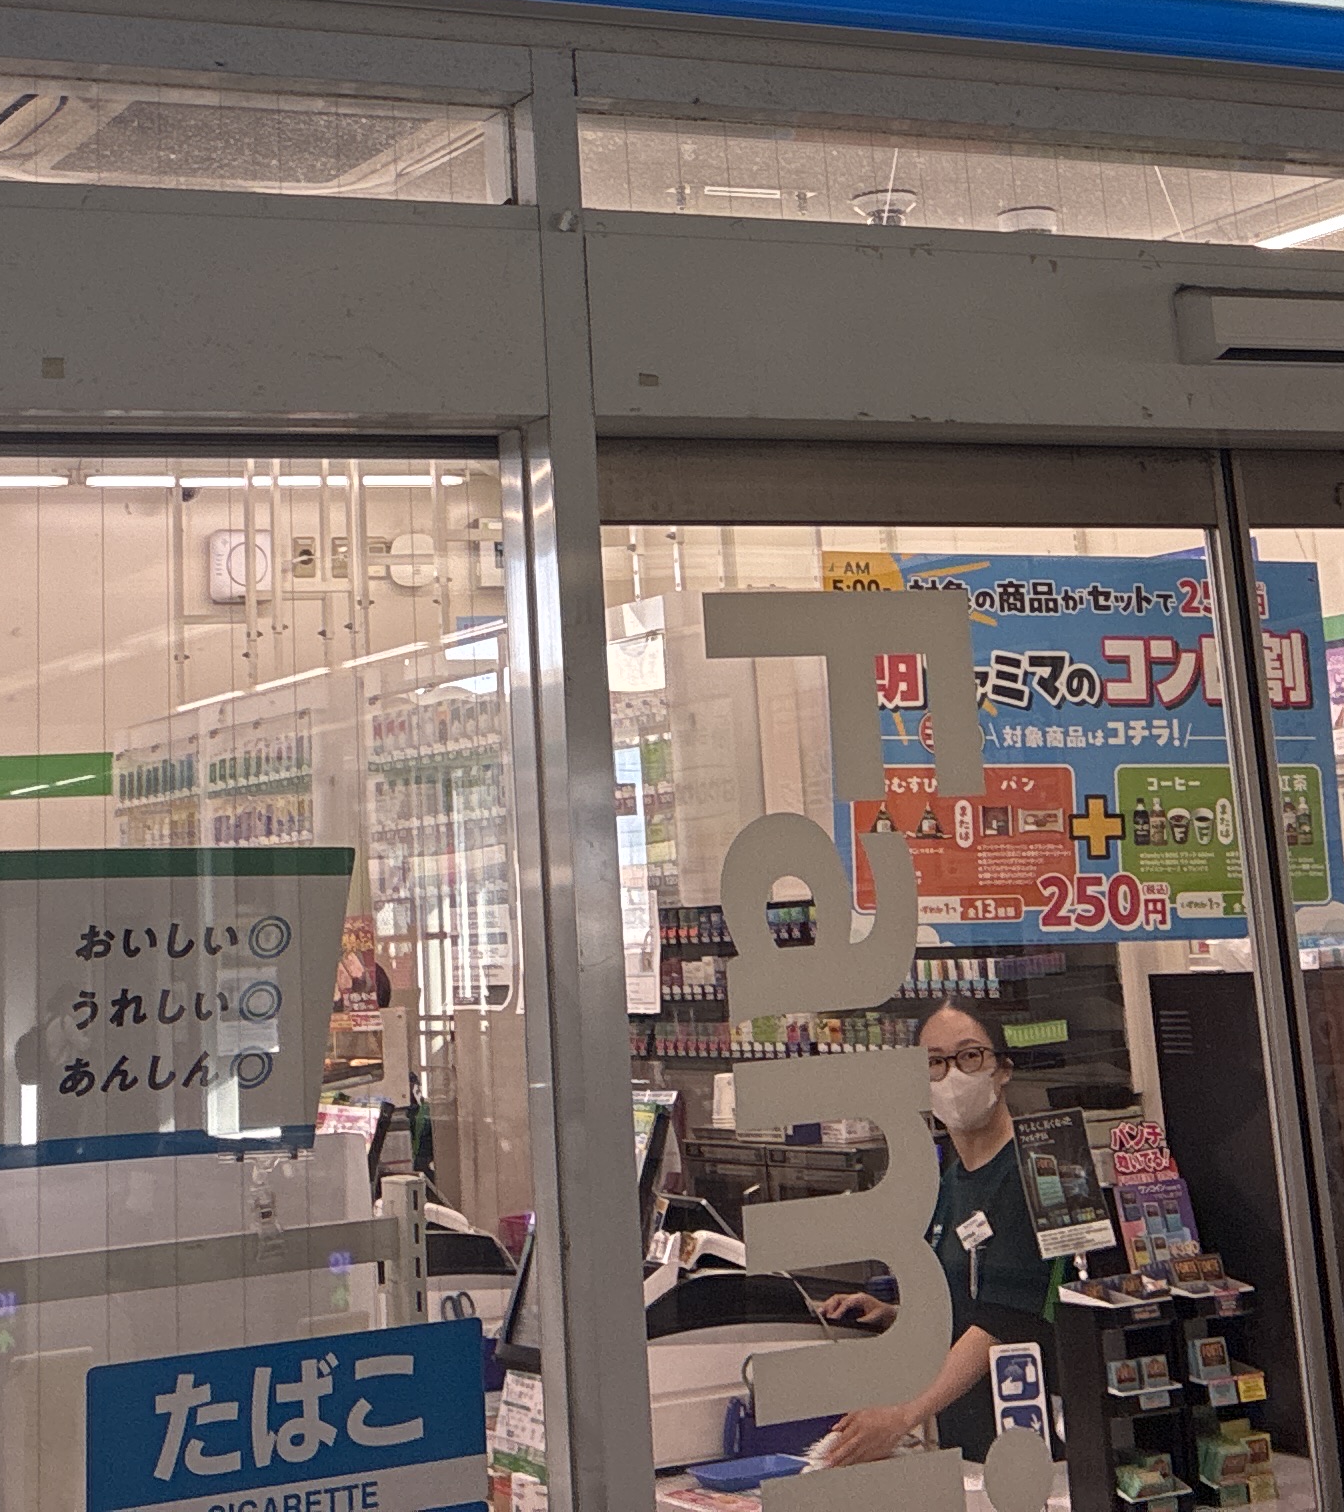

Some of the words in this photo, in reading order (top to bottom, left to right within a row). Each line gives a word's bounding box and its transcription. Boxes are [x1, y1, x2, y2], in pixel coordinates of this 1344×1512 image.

[1147, 776, 1202, 791] コーヒー
[1038, 873, 1171, 930] 250円
[75, 920, 240, 961] おいしい
[70, 986, 232, 1031] うれしい
[56, 1052, 220, 1098] あんしん
[153, 1352, 426, 1481] たばこ
